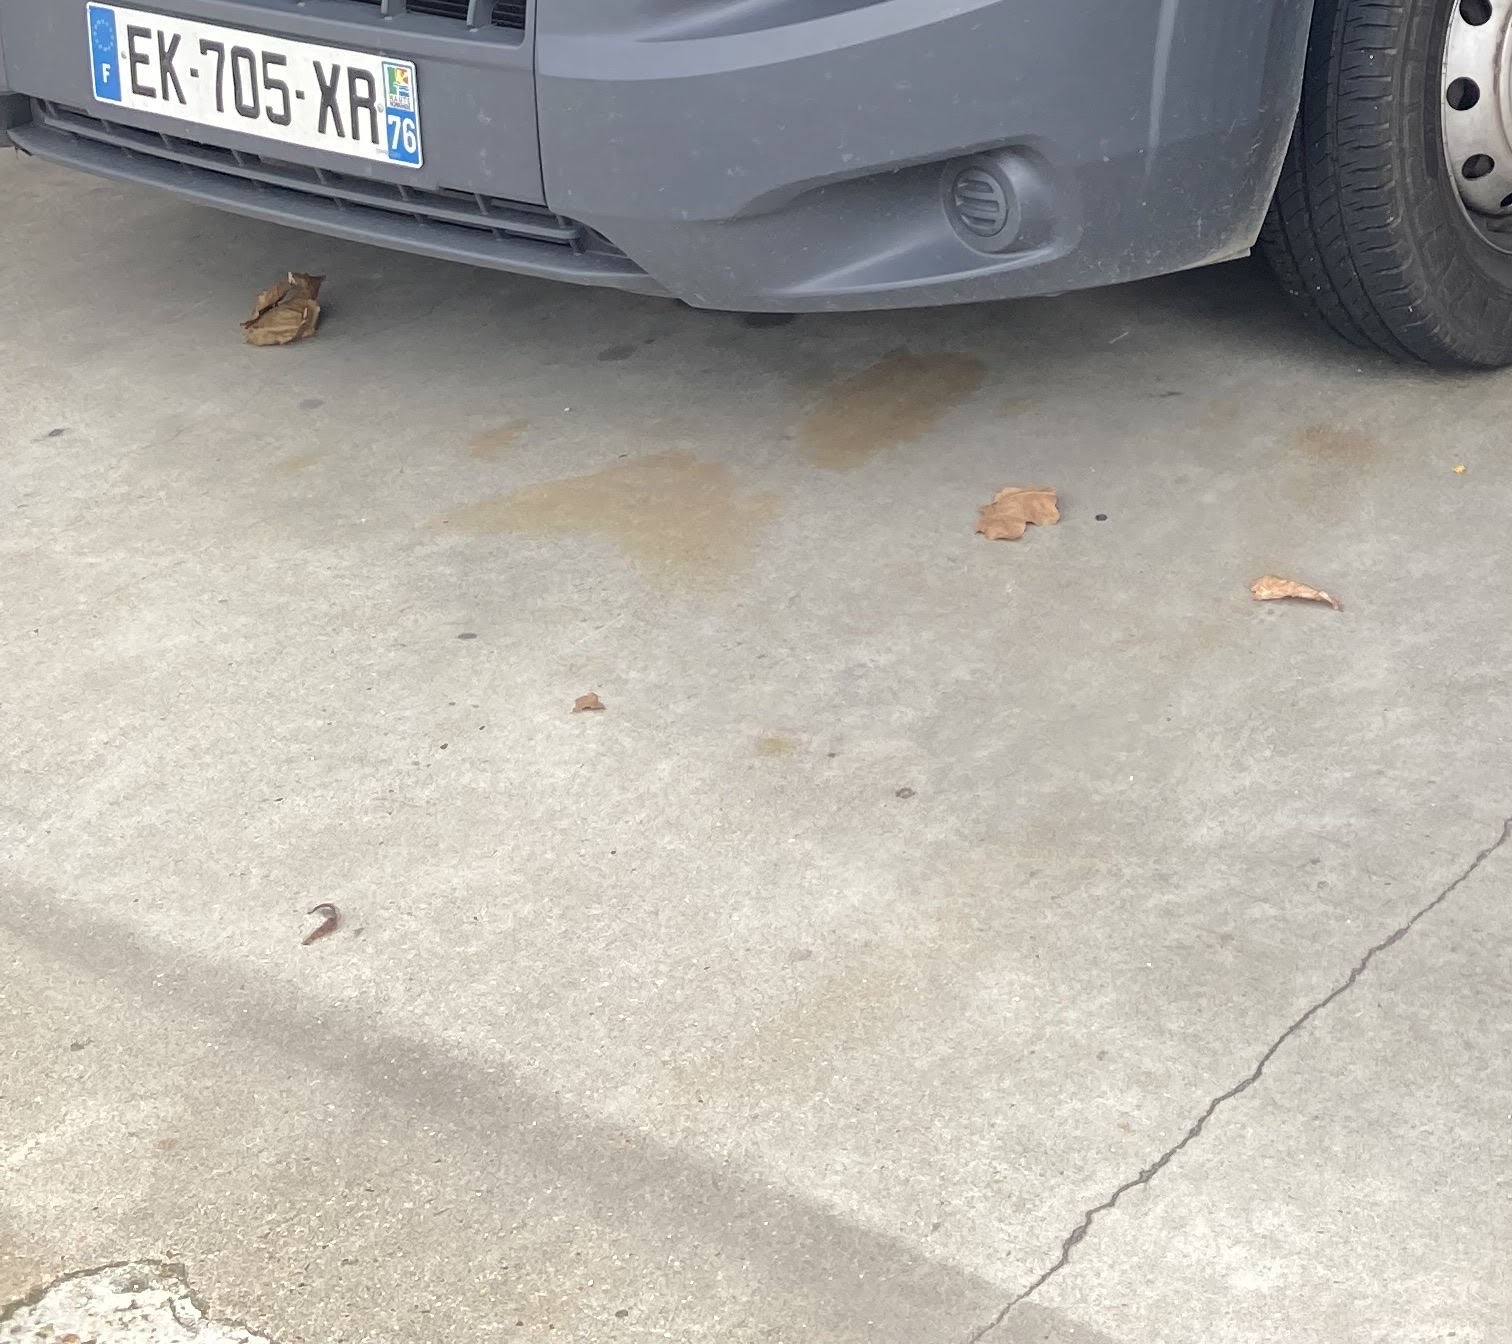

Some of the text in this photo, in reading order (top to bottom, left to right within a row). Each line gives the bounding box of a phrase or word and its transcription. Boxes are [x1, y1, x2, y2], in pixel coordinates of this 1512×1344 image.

[102, 23, 380, 145] F EK-705-XR
[387, 114, 417, 155] 76
